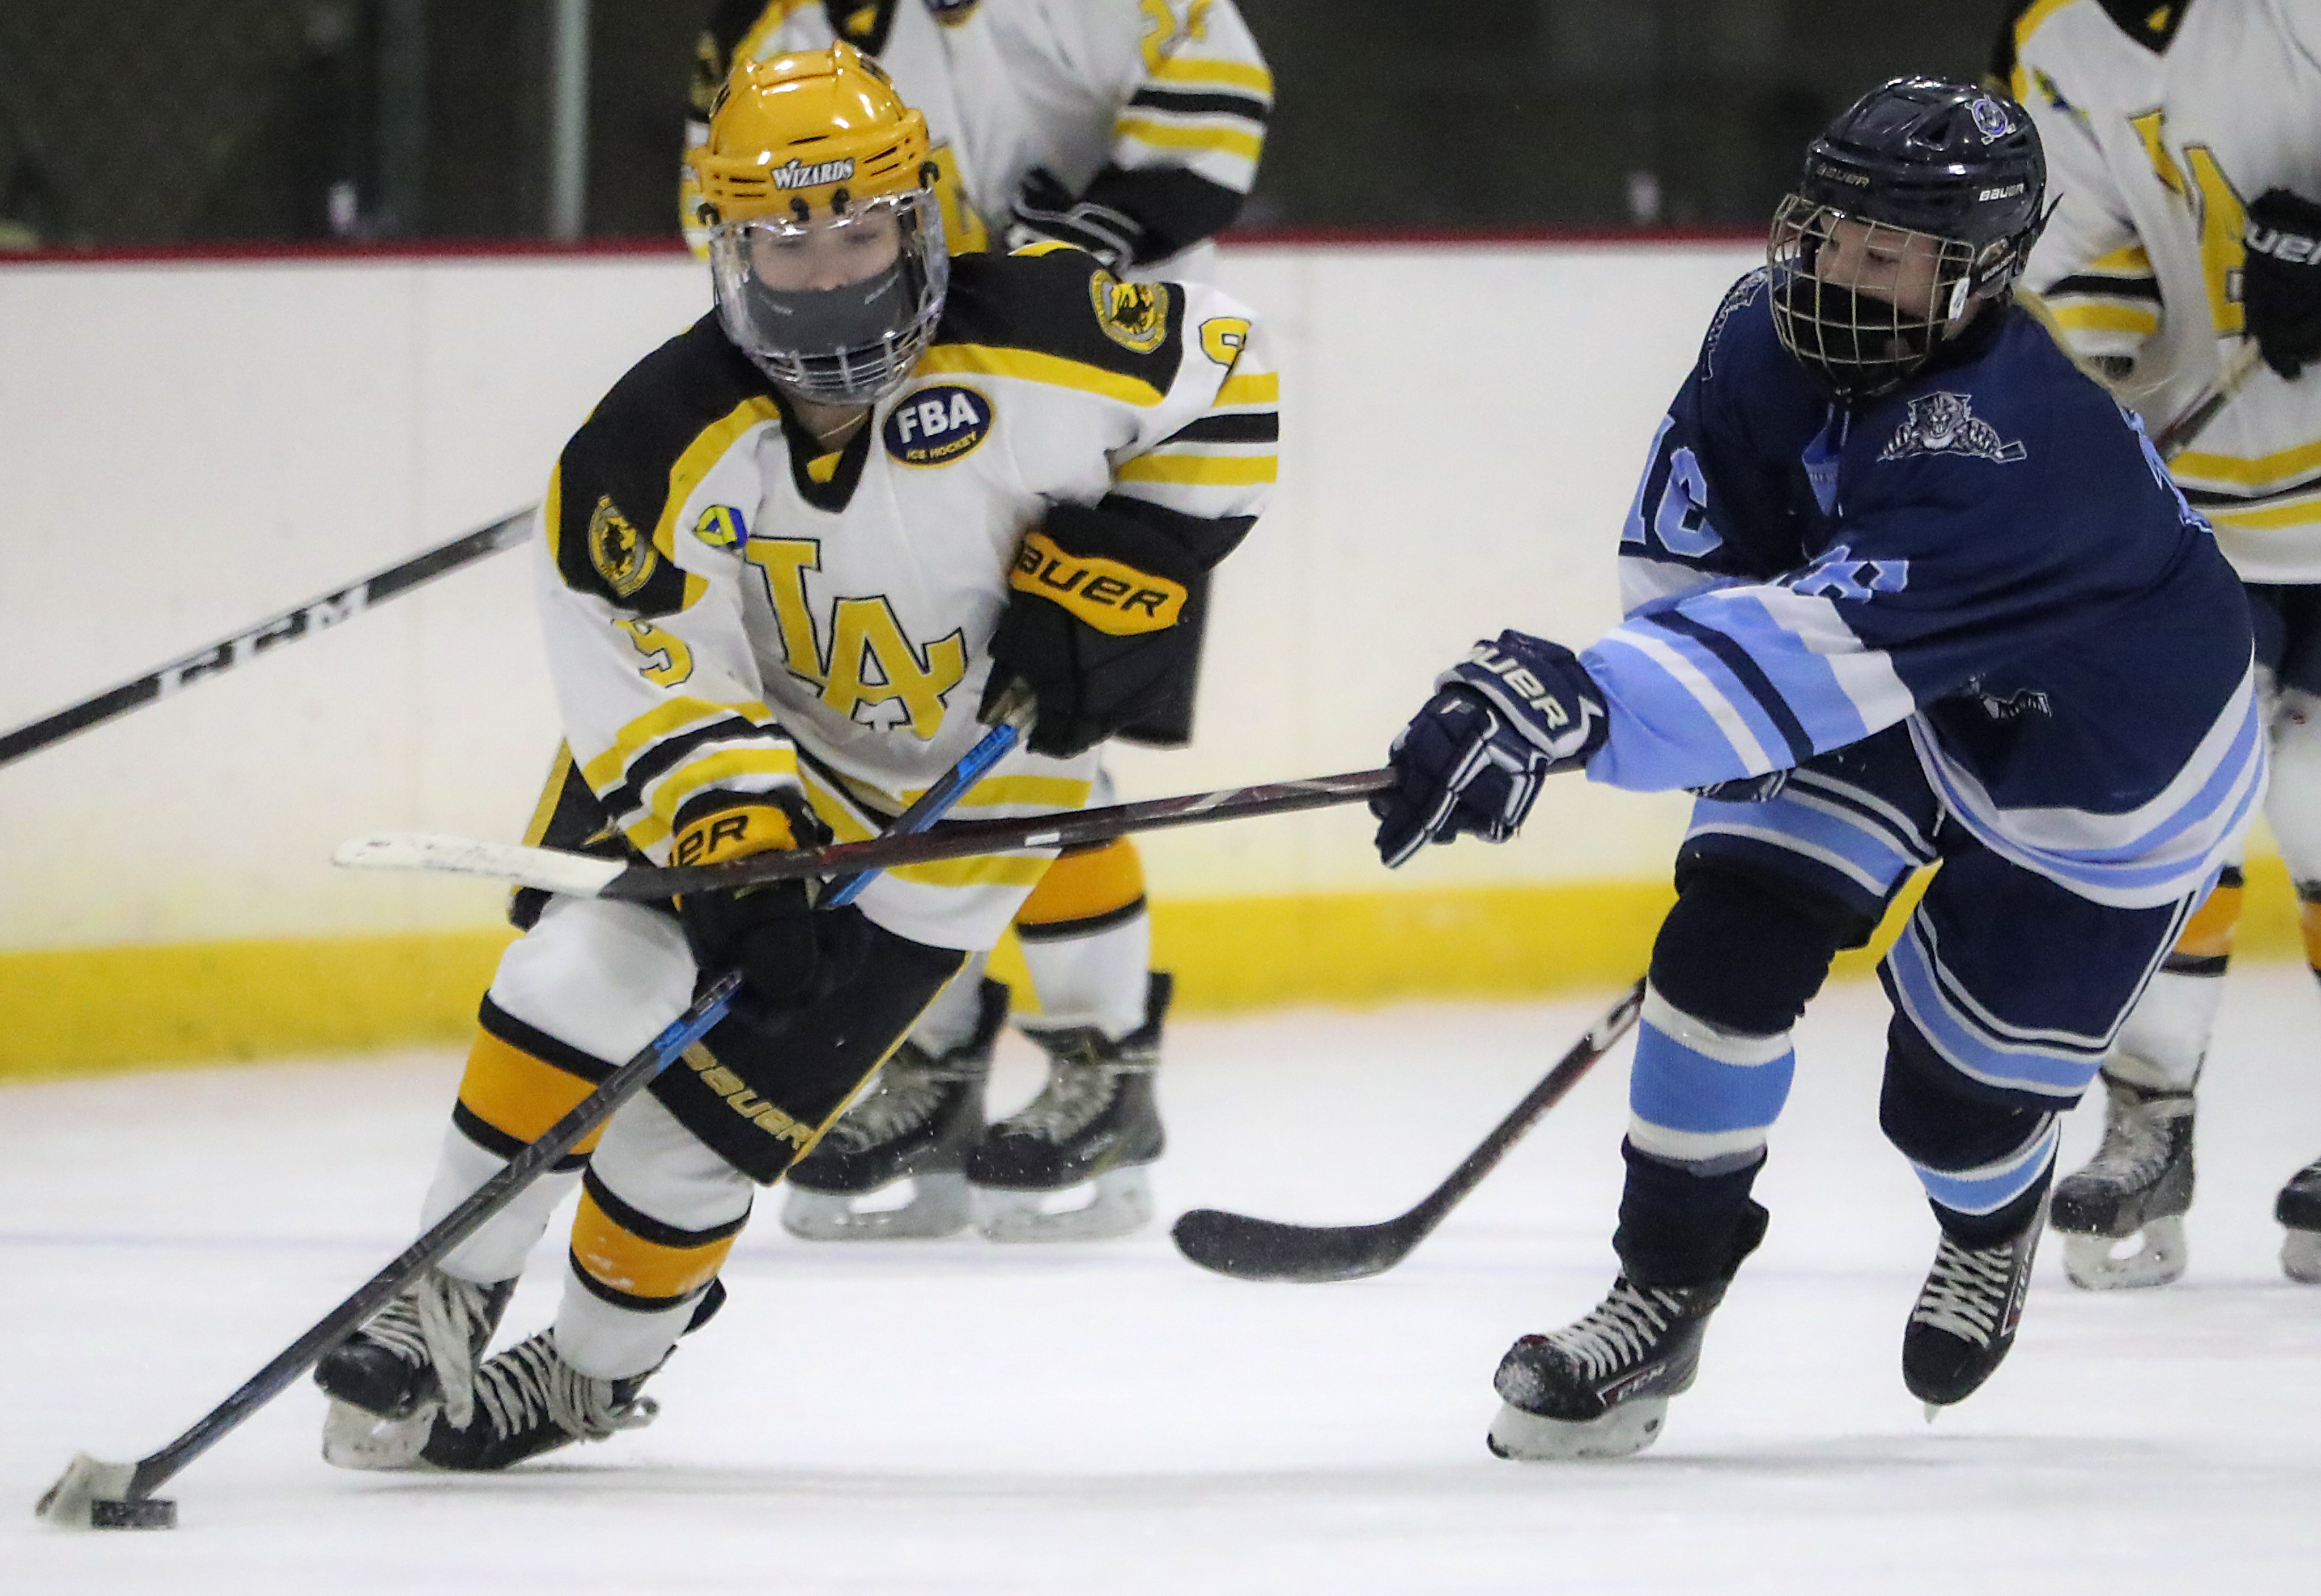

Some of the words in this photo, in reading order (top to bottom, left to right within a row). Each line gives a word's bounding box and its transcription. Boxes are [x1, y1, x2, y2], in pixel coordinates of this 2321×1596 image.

[771, 158, 855, 190] WIZARDS
[1979, 183, 2024, 202] BAUER
[896, 392, 981, 444] FBA
[906, 449, 926, 460] ICE
[929, 430, 977, 459] HOCKEY
[1015, 544, 1170, 619] AUER
[744, 533, 968, 740] LA
